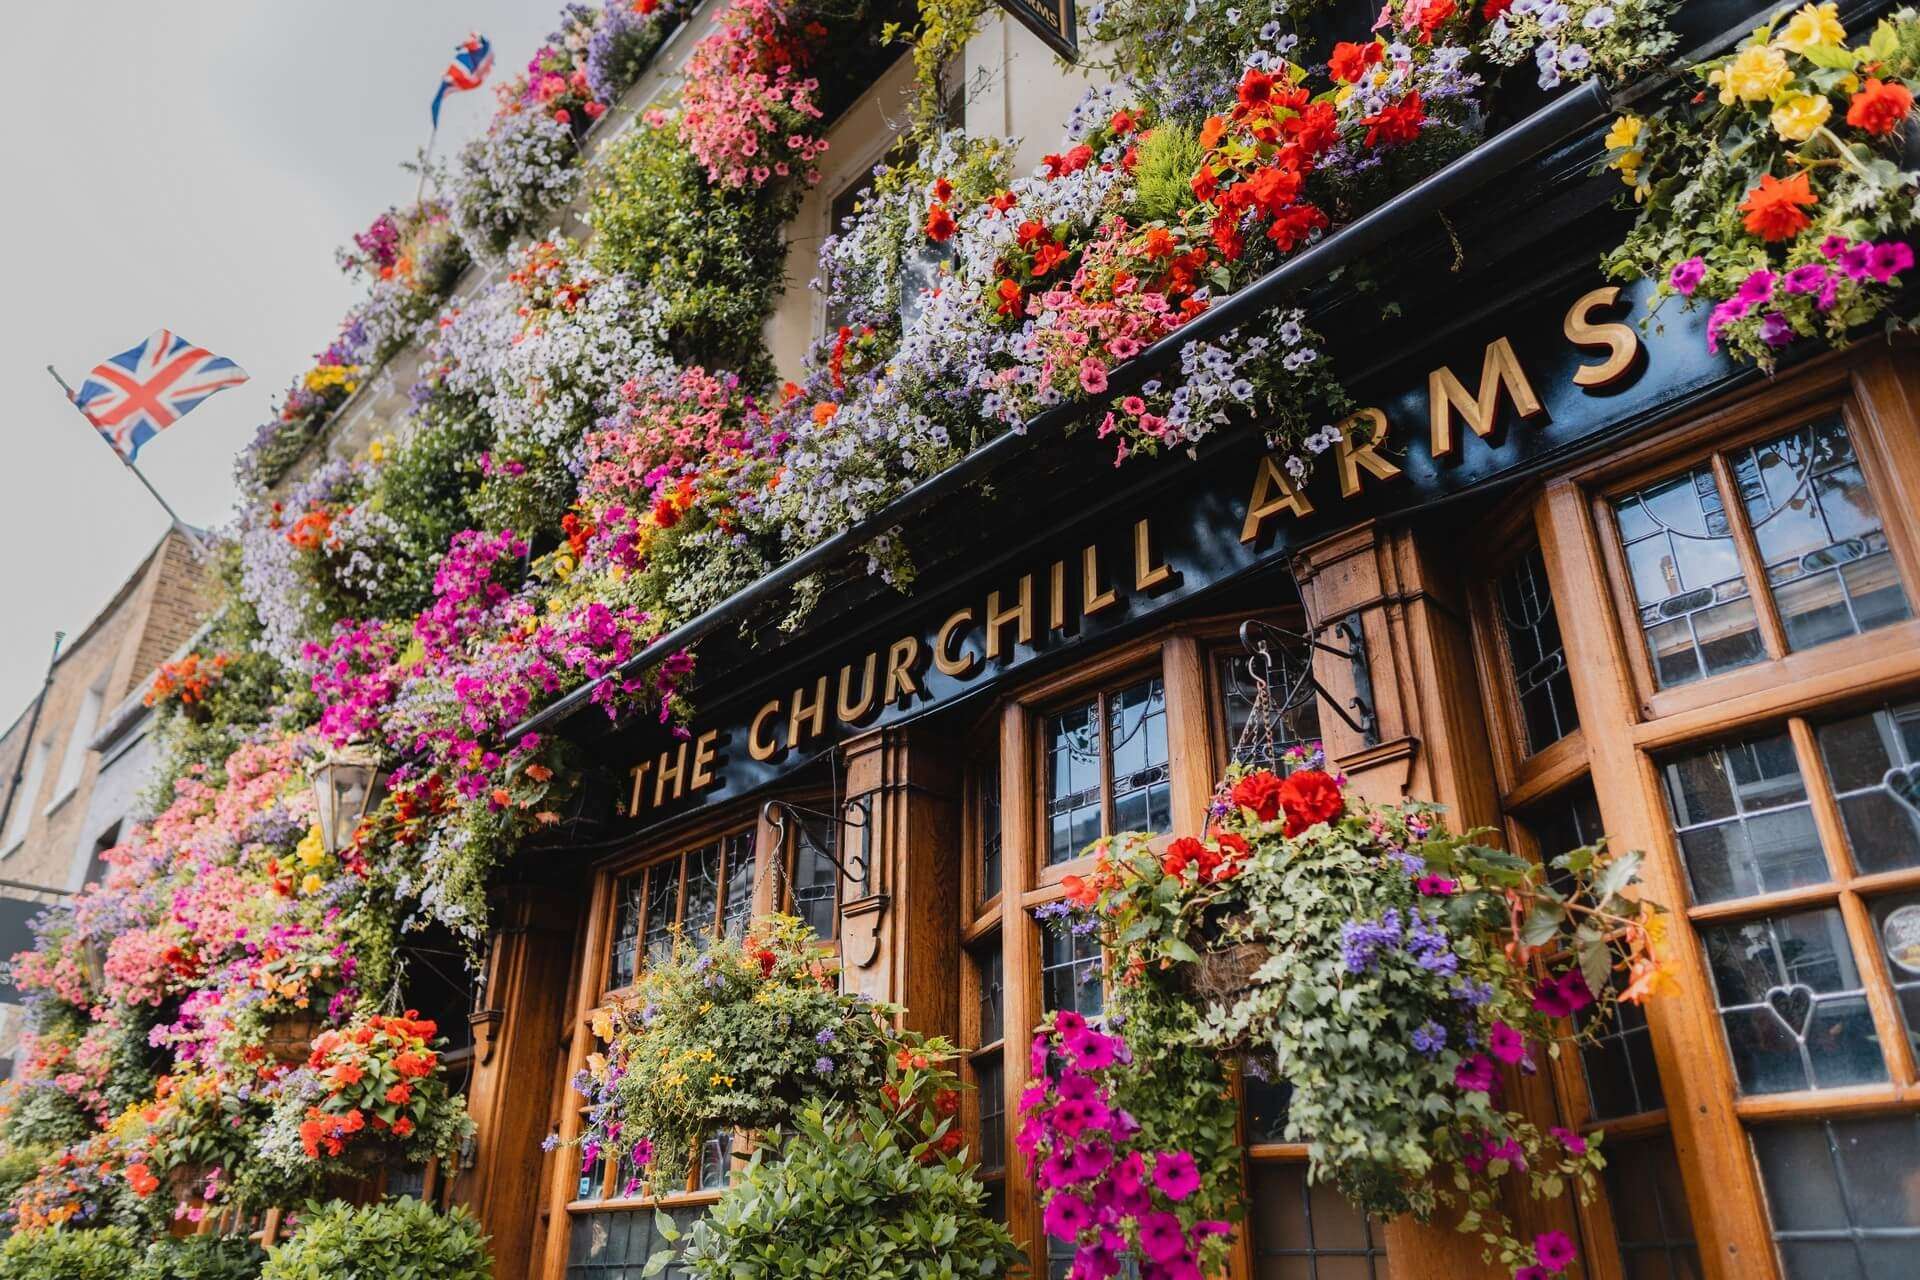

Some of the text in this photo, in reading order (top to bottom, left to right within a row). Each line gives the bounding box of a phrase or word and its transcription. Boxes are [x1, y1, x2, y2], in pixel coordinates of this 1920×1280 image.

[629, 286, 1638, 818] THE CHURCHILL ARMS
